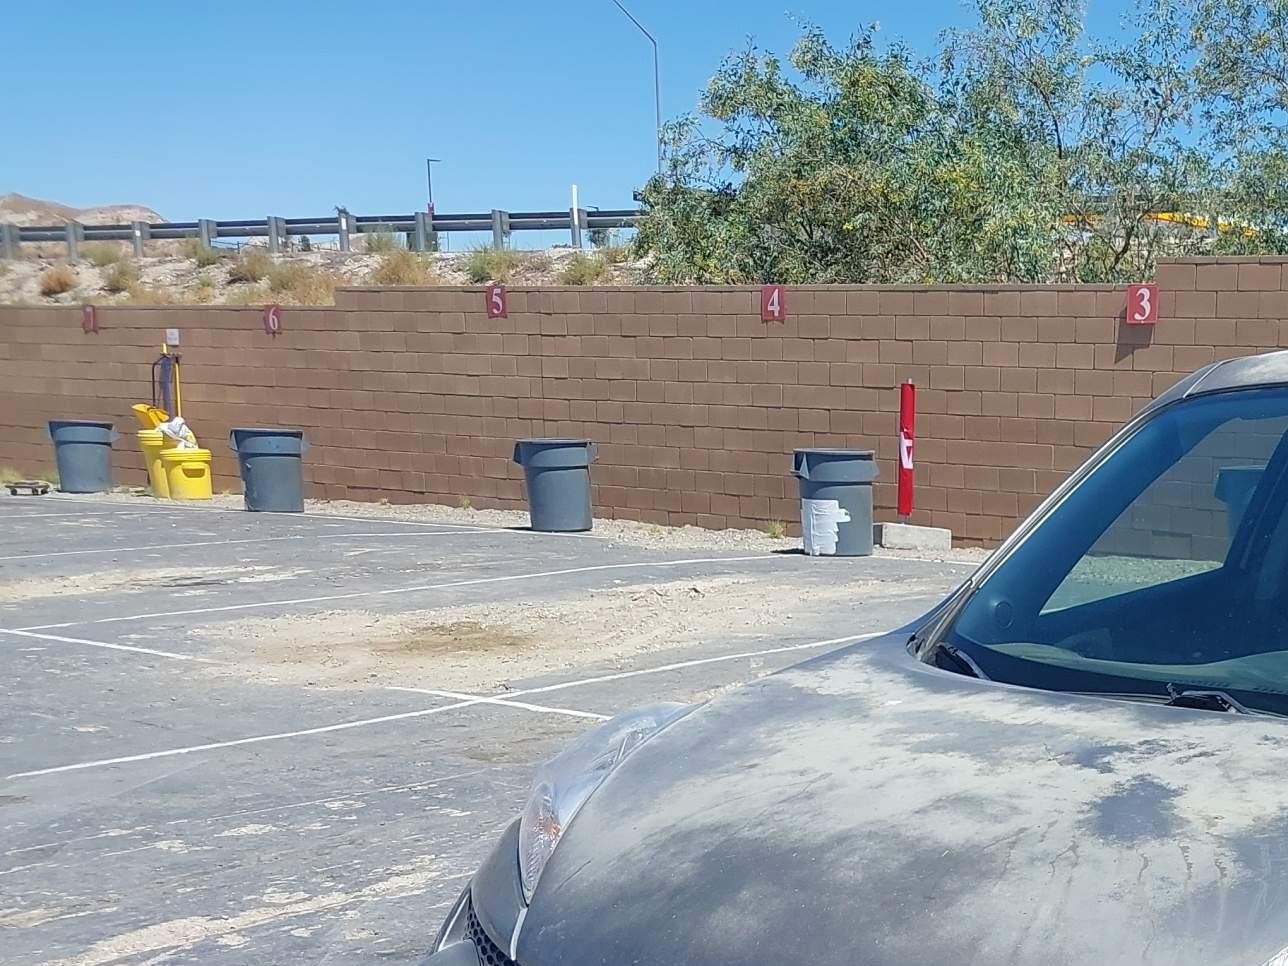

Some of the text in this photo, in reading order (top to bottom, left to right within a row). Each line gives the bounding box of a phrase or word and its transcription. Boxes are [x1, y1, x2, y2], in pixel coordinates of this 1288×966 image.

[492, 288, 503, 314] 5
[767, 288, 780, 317] 4
[1134, 287, 1151, 321] 3
[269, 306, 278, 330] 6
